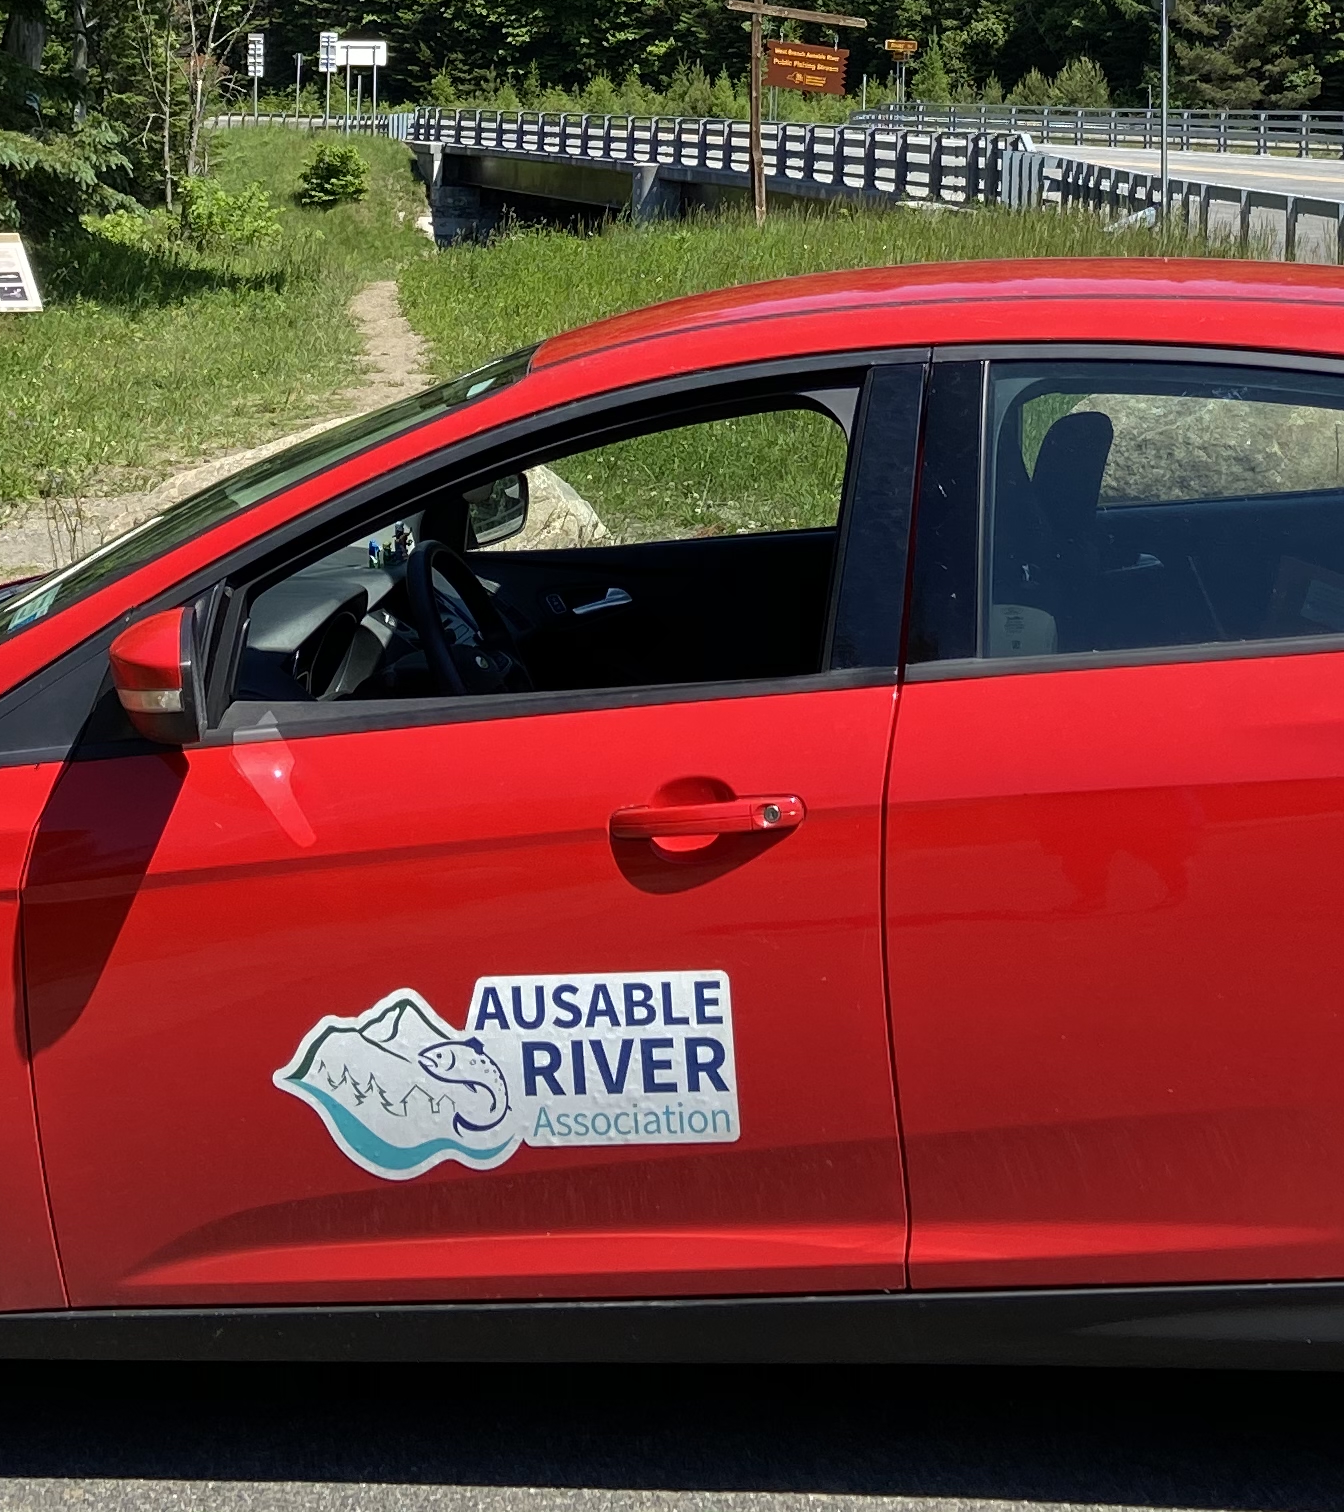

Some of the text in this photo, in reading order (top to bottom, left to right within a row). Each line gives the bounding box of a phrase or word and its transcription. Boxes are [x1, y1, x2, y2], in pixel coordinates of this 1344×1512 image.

[773, 57, 839, 72] Public Fishing Stream
[474, 980, 723, 1031] AUSABLE
[521, 1036, 731, 1097] RIVER
[533, 1101, 731, 1138] Association
